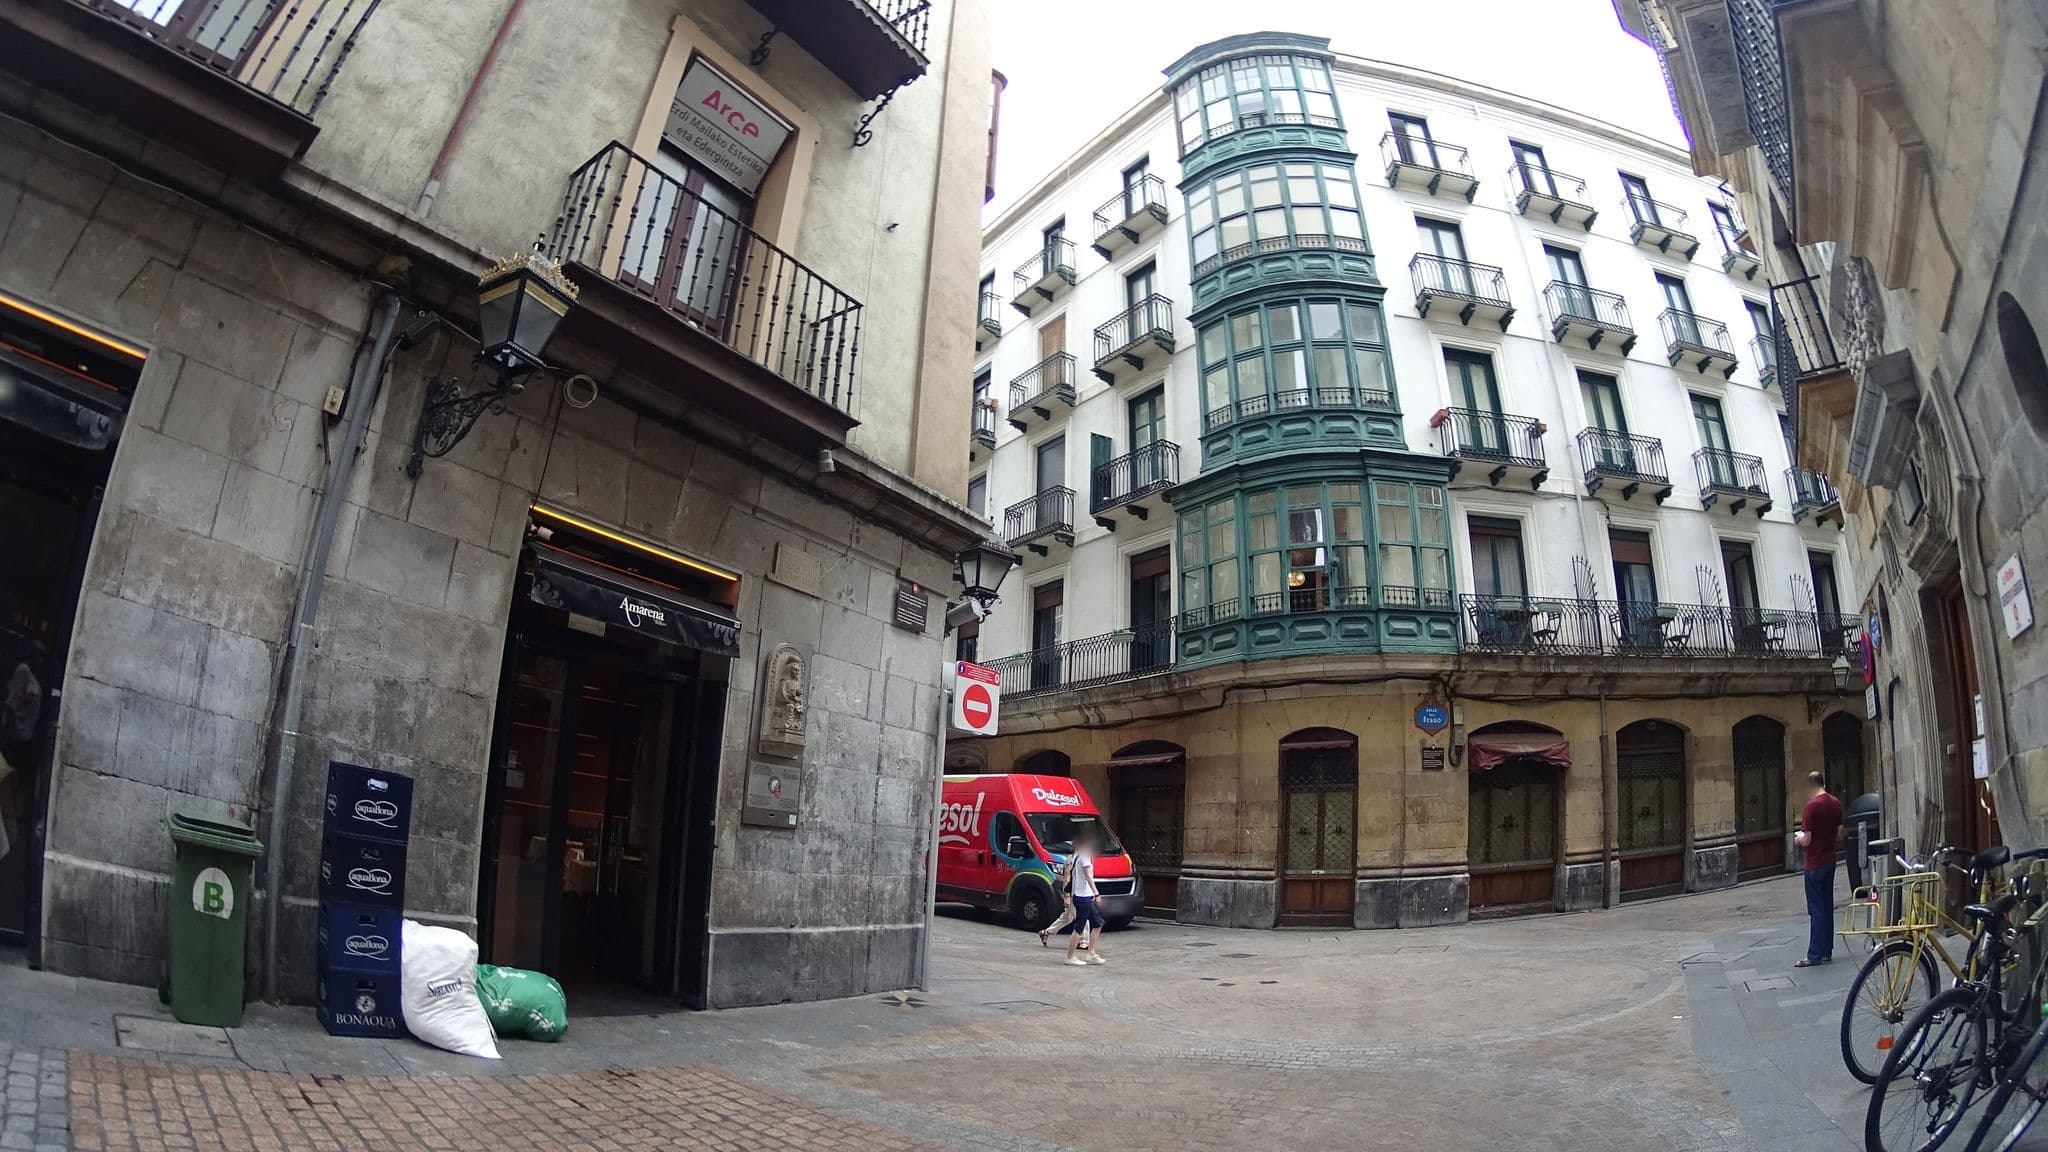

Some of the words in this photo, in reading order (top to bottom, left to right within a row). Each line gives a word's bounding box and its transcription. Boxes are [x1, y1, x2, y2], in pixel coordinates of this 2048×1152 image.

[701, 89, 760, 138] Arce
[676, 127, 693, 142] eta
[693, 137, 743, 177] Edergintza
[690, 117, 727, 148] Mailako
[728, 143, 765, 174] Estetika
[619, 596, 665, 627] Amarena
[1031, 787, 1081, 806] Dulcesol
[203, 880, 225, 913] B
[335, 1013, 397, 1029] BONAQUA
